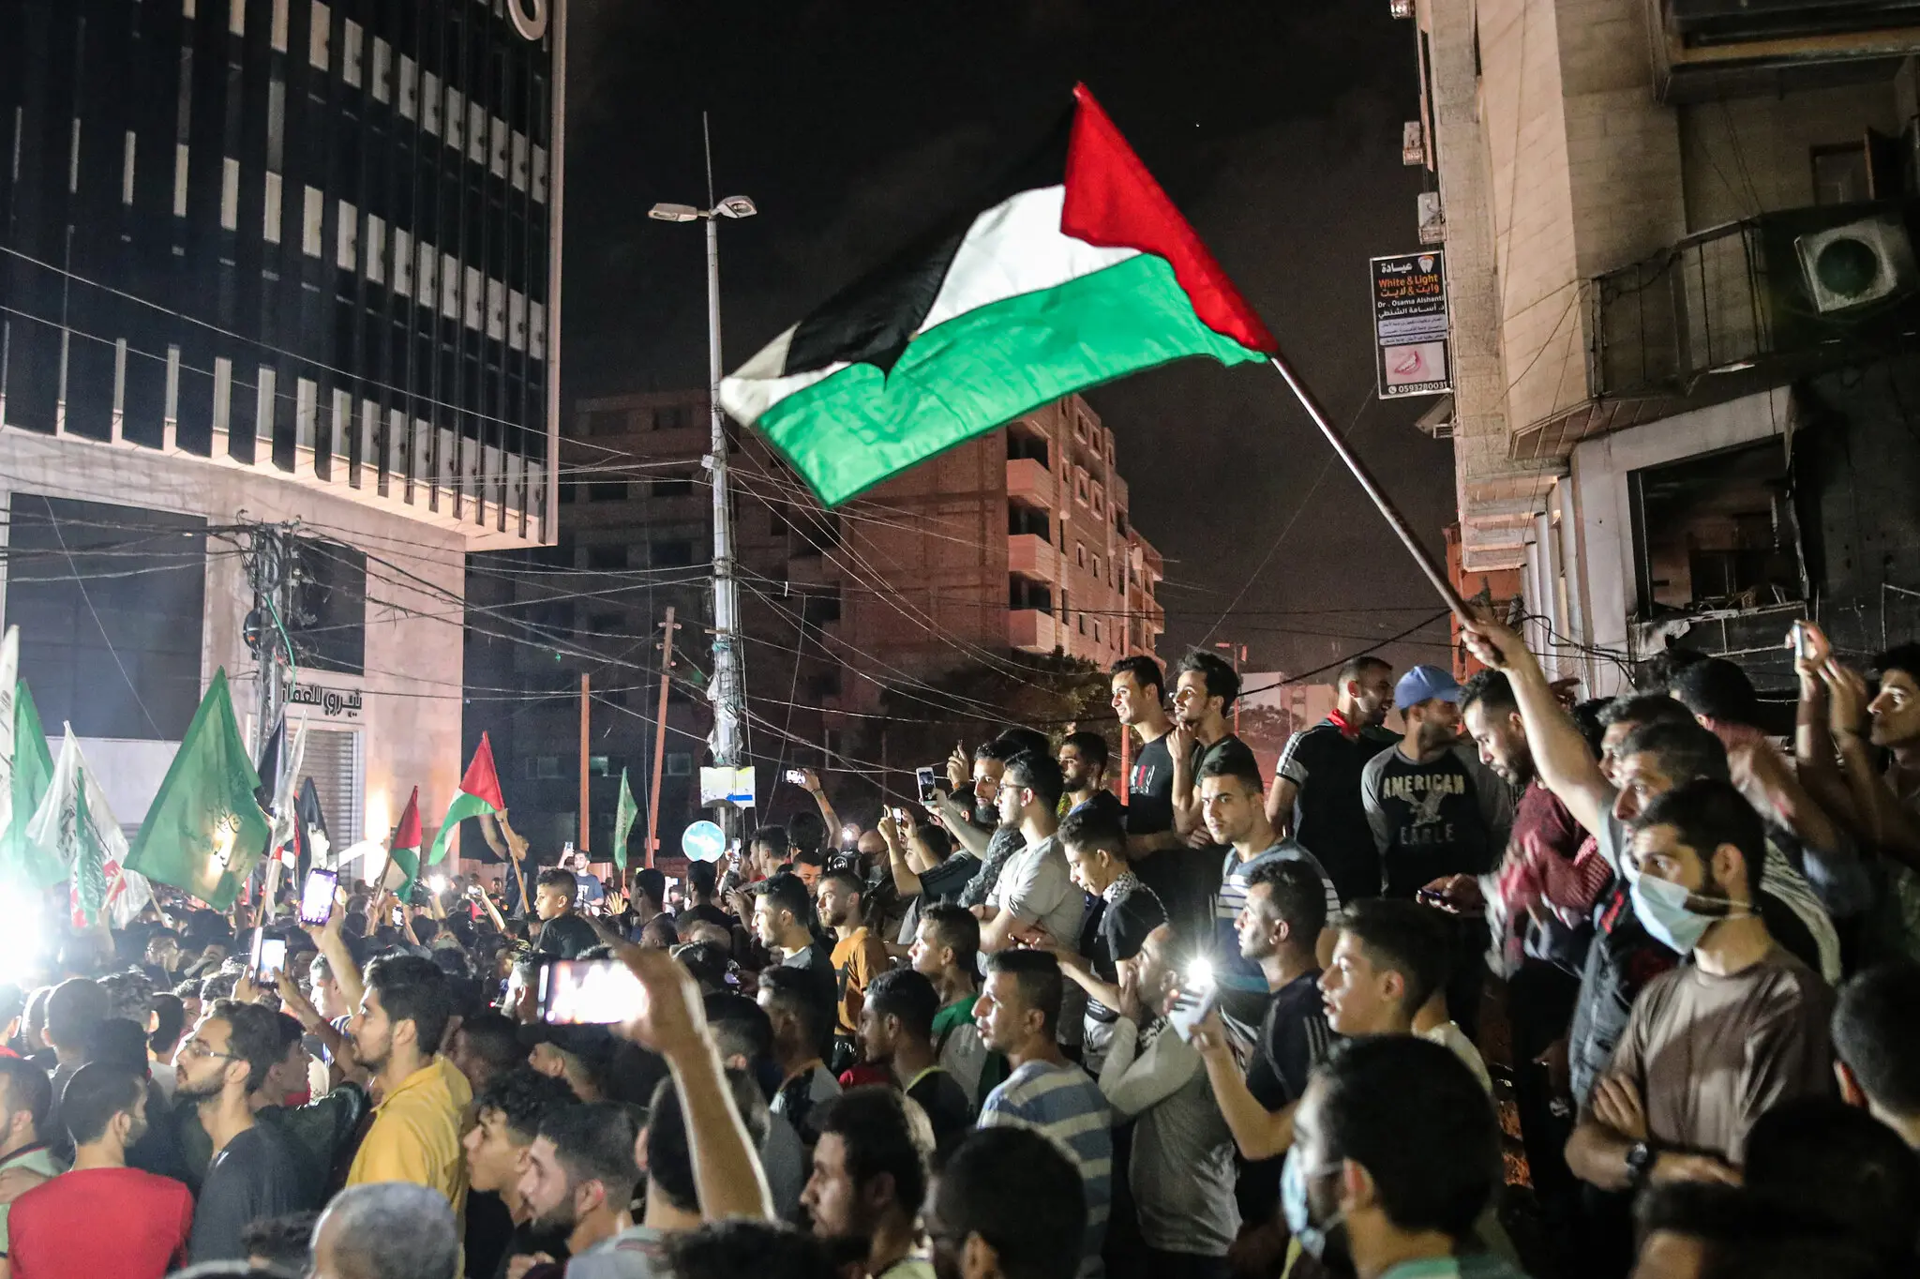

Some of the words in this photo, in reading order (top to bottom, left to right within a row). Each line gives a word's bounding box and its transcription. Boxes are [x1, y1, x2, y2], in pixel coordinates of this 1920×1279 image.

[1381, 262, 1413, 274] عيادة
[1379, 277, 1405, 288] White
[1407, 276, 1414, 285] &
[1414, 274, 1439, 286] Light
[1380, 287, 1406, 299] لايت
[1408, 286, 1415, 296] &
[1416, 284, 1440, 295] وايت
[1416, 295, 1445, 304] Alshanti
[1378, 308, 1408, 319] الشنطي
[1409, 303, 1437, 313] أسامة
[1383, 773, 1465, 799] AMERICAN
